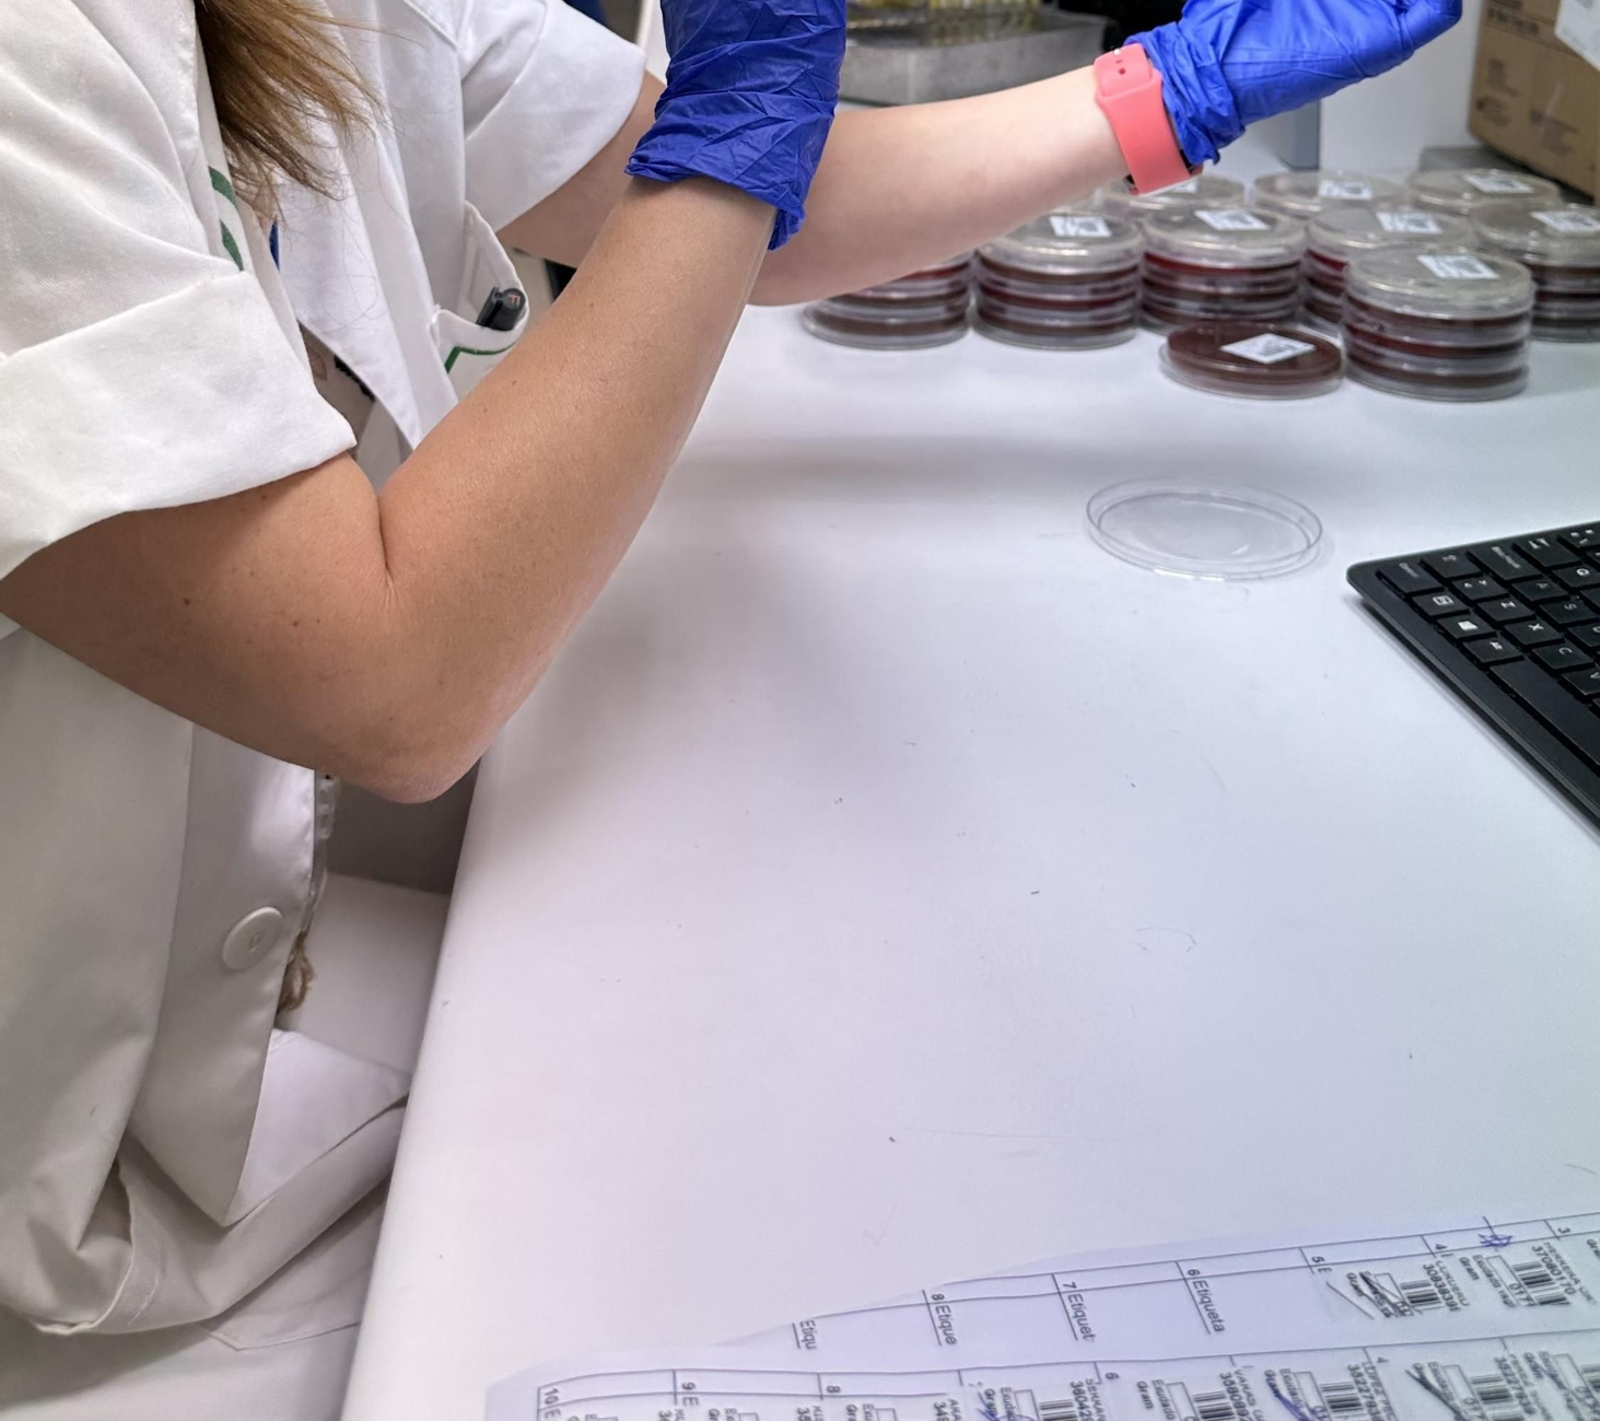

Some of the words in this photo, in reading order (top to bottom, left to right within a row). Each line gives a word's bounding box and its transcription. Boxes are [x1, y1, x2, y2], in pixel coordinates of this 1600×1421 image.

[1528, 623, 1544, 631] X
[1558, 647, 1573, 655] C
[1459, 1256, 1480, 1280] Gram
[1192, 1279, 1226, 1332] Etiqueta
[935, 1304, 957, 1346] Etique
[1067, 1292, 1097, 1342] Etiquet
[800, 1319, 818, 1350] Etiqu
[682, 1382, 696, 1390] 9
[1105, 1372, 1119, 1380] 6
[544, 1387, 560, 1405] 10
[827, 1385, 841, 1393] 8
[1136, 1381, 1154, 1409] Gram
[682, 1396, 699, 1406] E
[1151, 1379, 1176, 1421] Exudado
